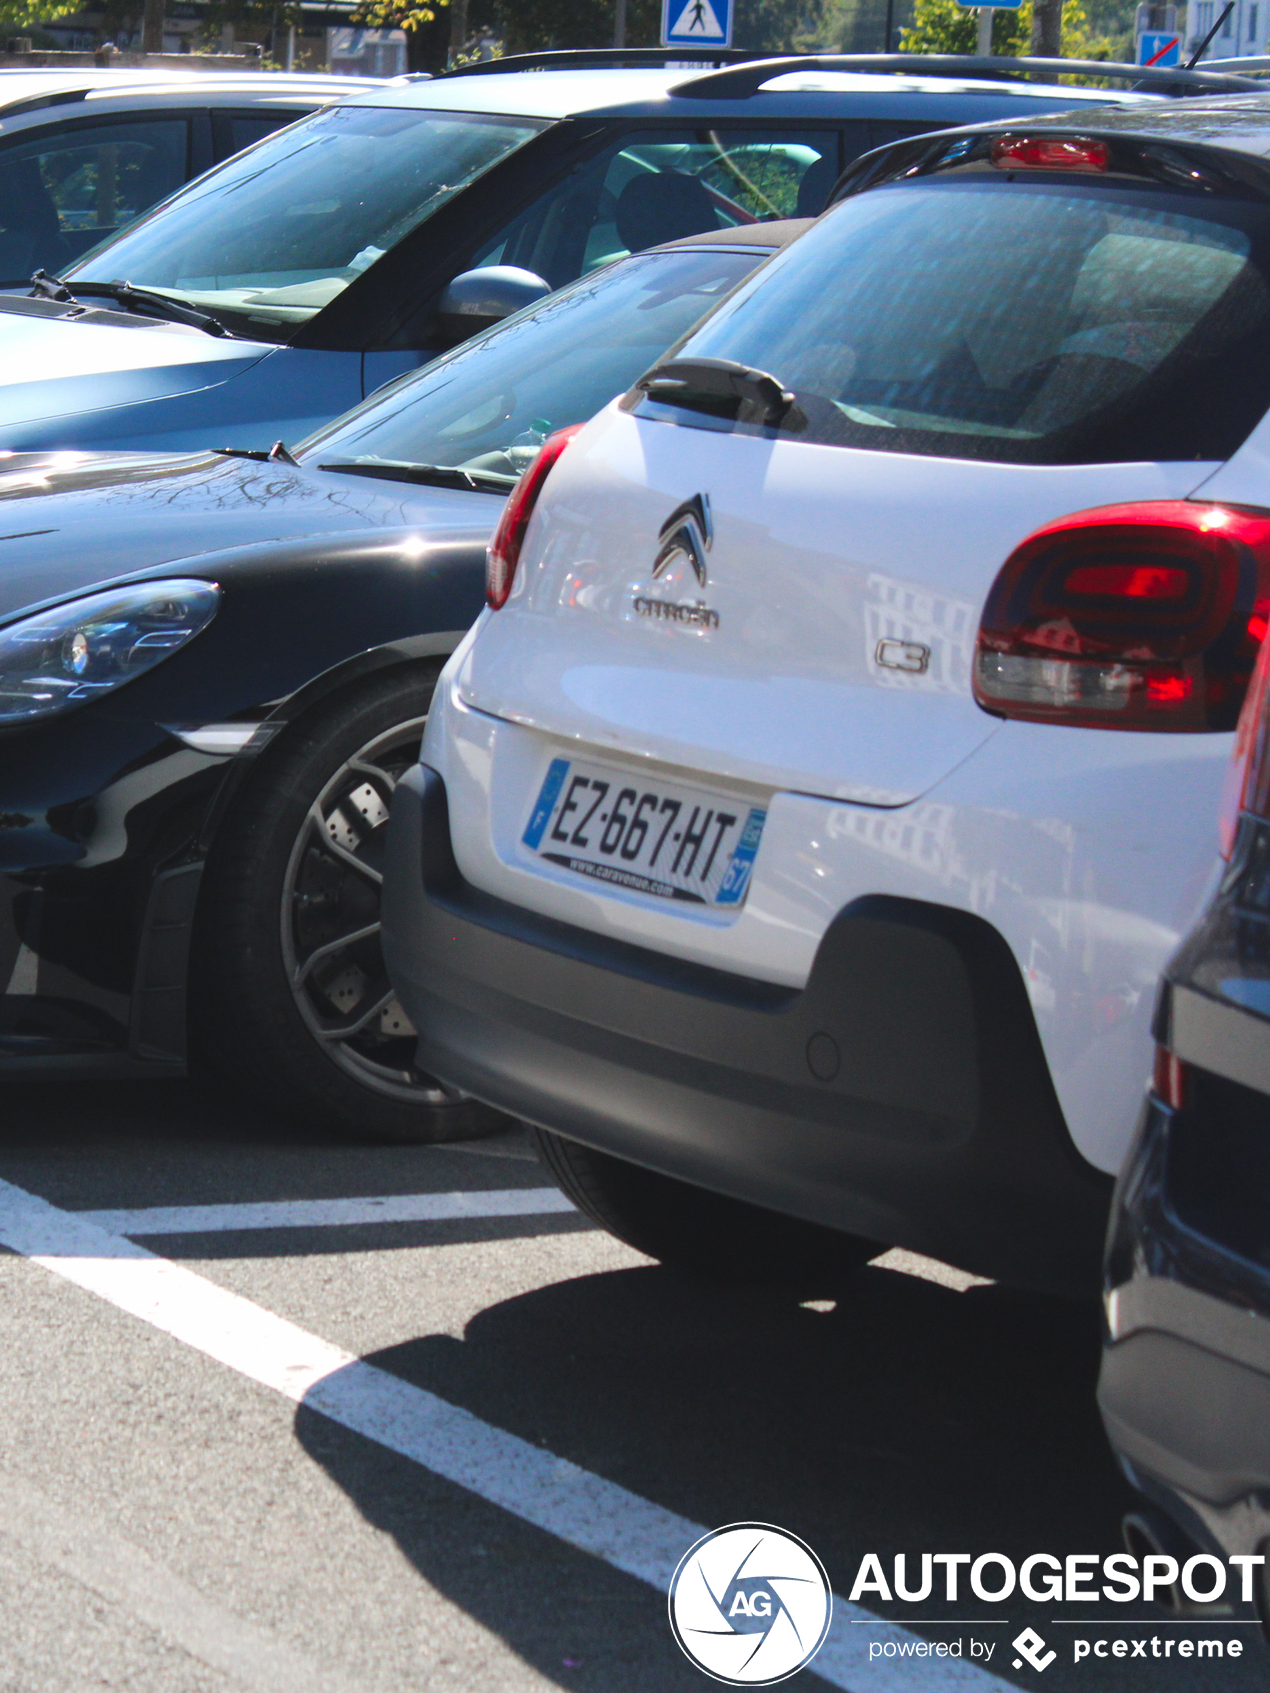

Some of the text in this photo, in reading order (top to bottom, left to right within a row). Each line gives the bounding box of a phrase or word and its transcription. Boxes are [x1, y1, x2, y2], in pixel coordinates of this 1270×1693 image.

[875, 637, 931, 674] C3
[551, 774, 738, 883] EZ-667-HT
[569, 858, 674, 899] www.caravenue.com
[723, 857, 751, 894] 67
